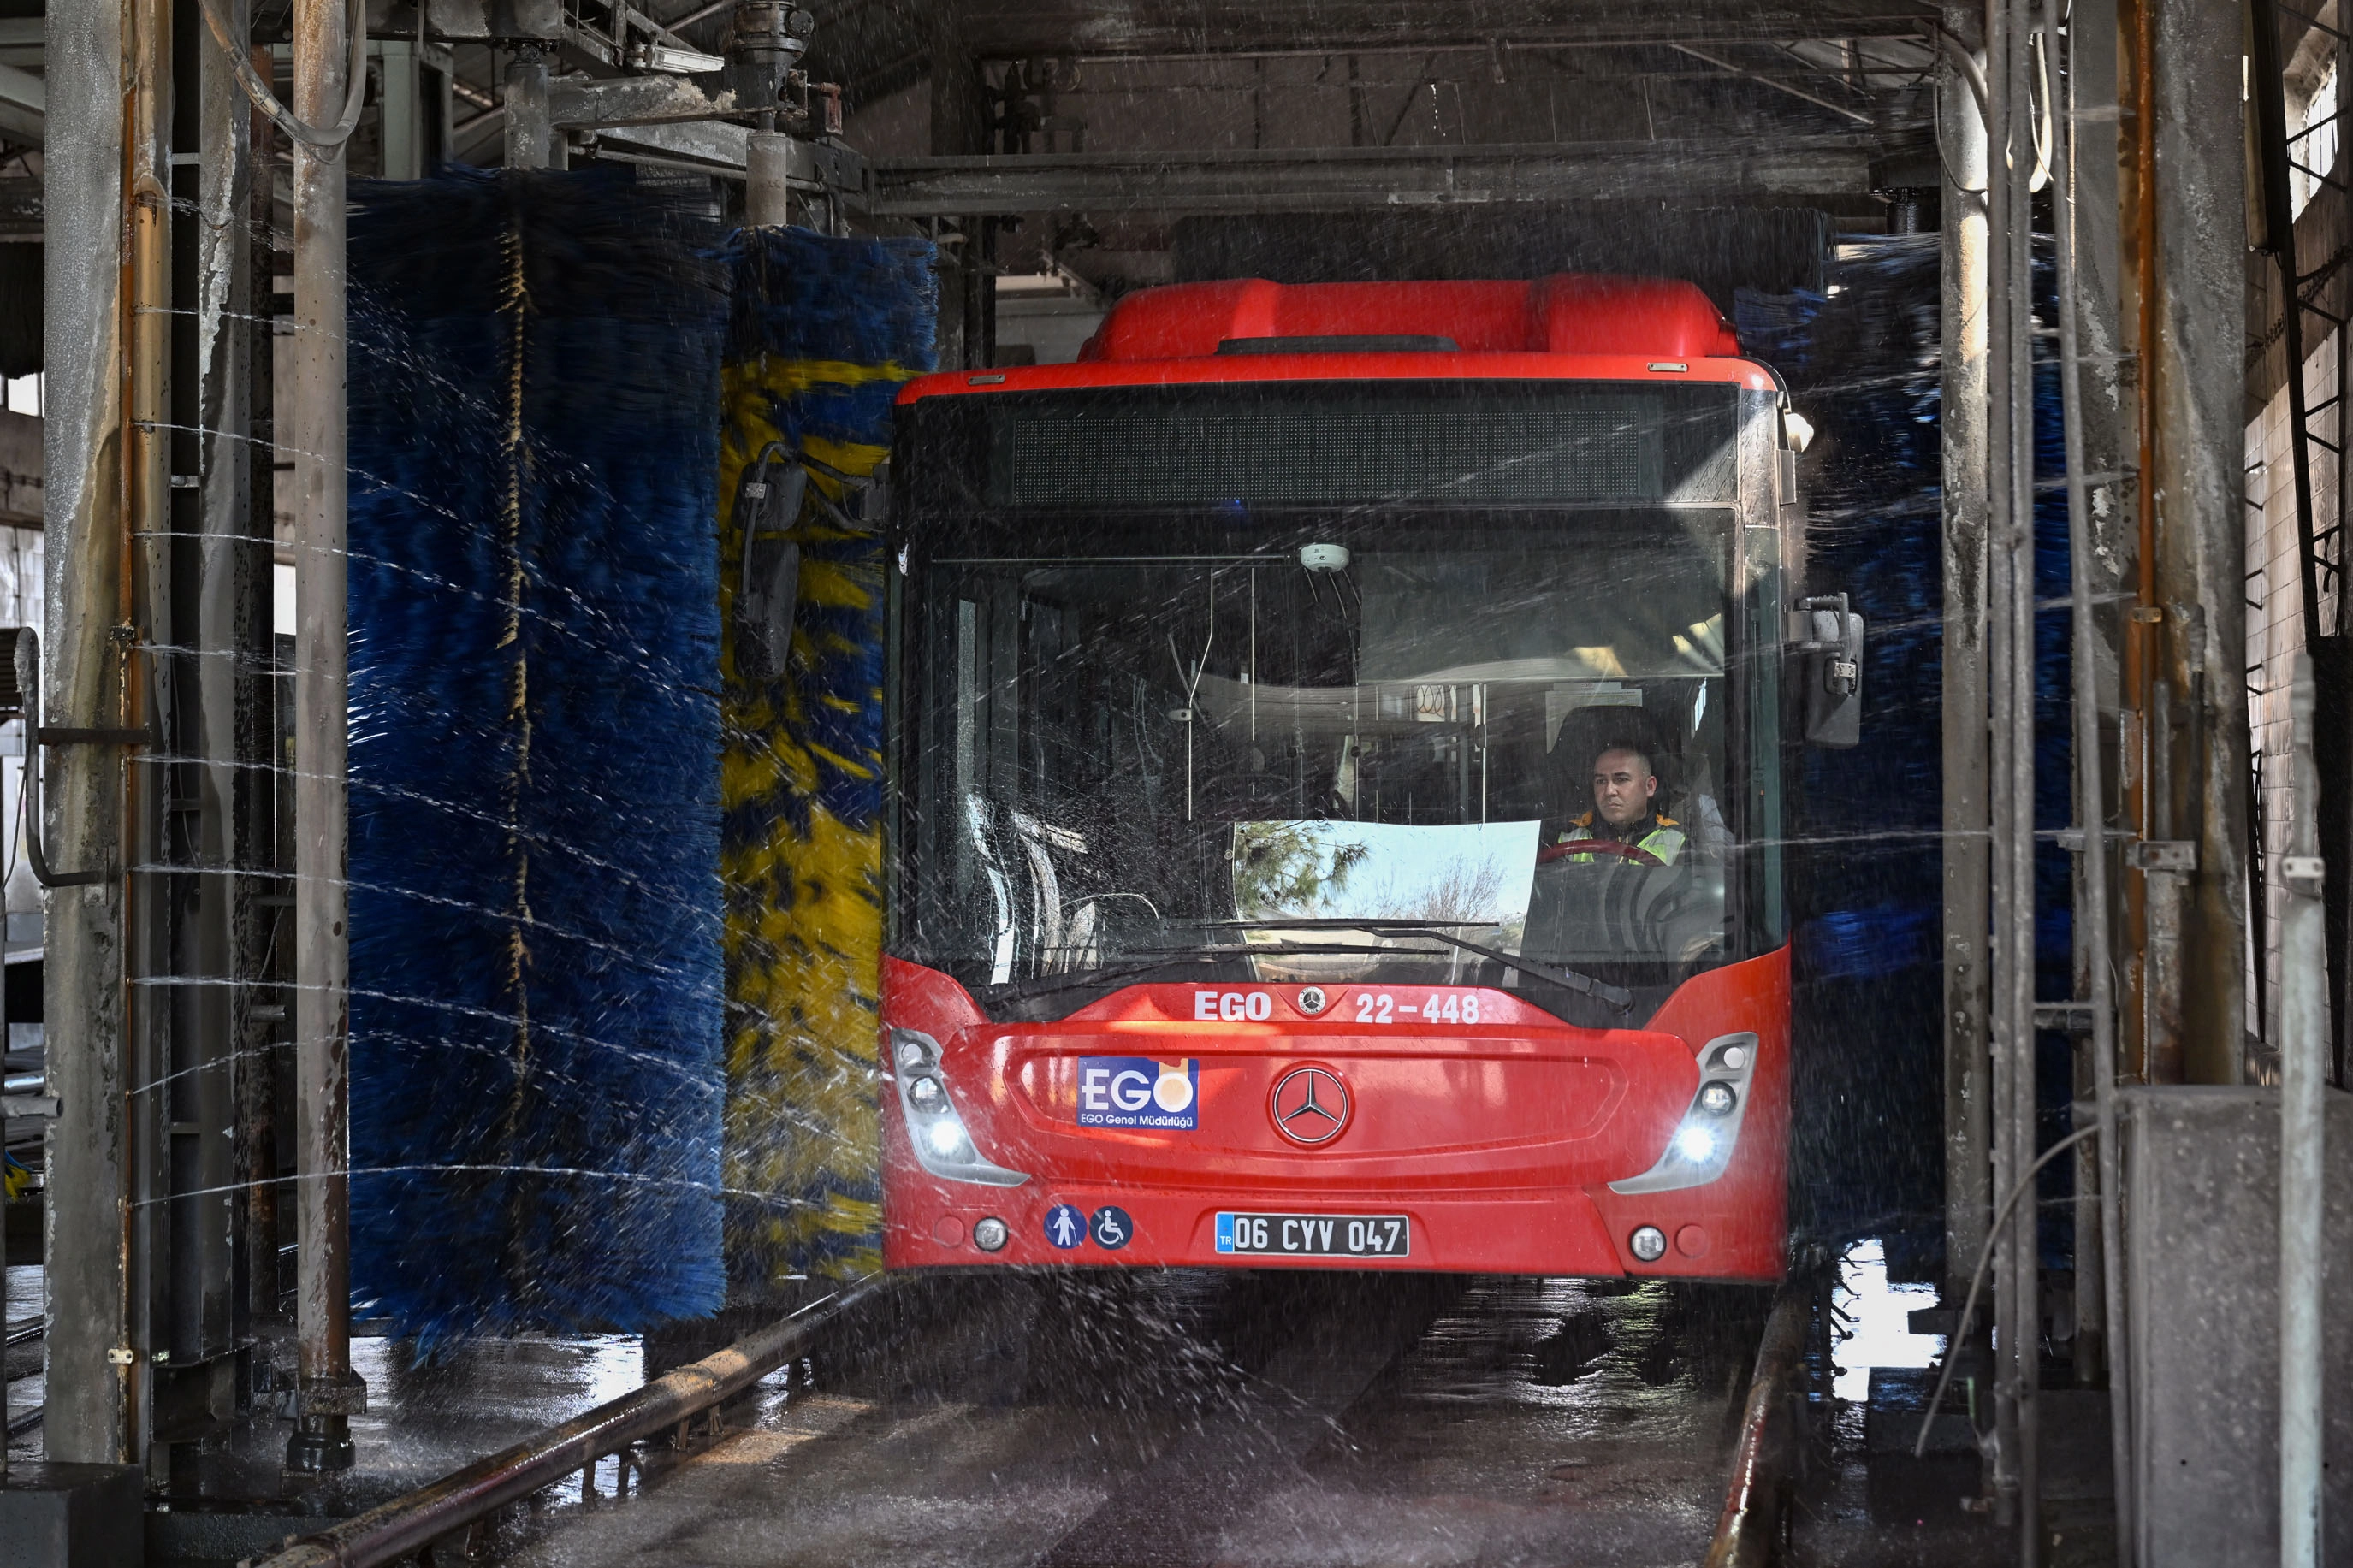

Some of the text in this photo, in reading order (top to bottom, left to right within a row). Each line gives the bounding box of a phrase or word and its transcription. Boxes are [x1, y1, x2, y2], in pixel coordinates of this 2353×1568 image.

[1194, 991, 1271, 1021] EGO
[1356, 993, 1479, 1024] 22-448
[1081, 1068, 1194, 1113] EGO
[1081, 1114, 1193, 1128] EGO Genel Müdürlüğü
[1219, 1235, 1232, 1246] TR
[1235, 1217, 1401, 1252] 06 CYV 047
